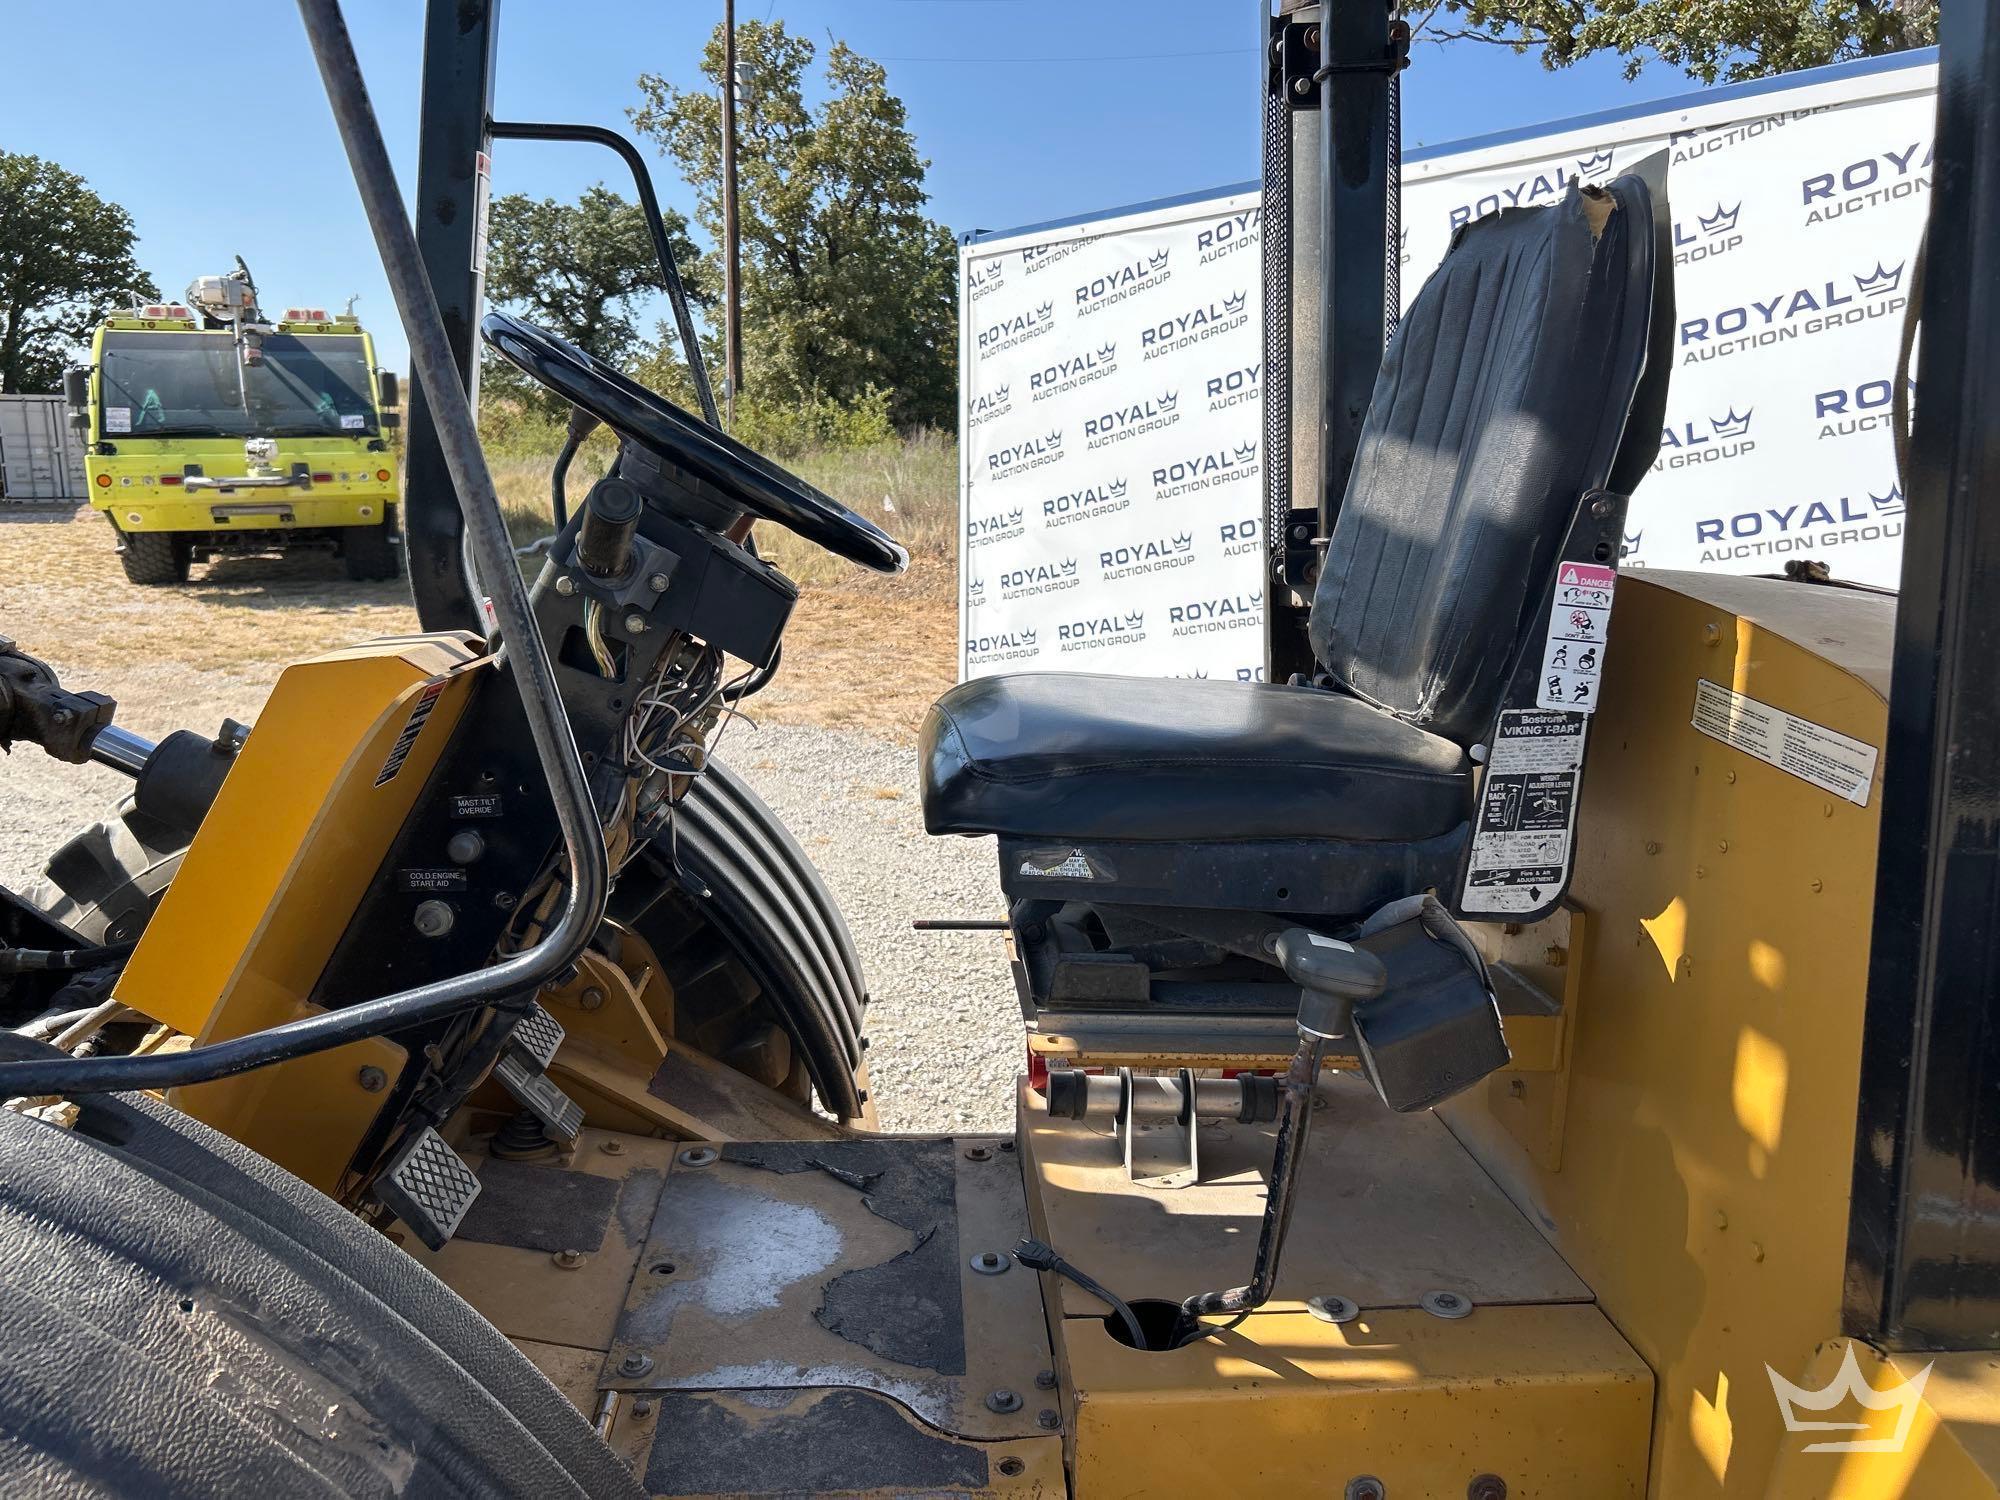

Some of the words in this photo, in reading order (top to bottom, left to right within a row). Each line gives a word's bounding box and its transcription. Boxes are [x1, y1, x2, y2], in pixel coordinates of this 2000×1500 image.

[1672, 113, 1785, 166] AUCTION
[1803, 138, 1935, 206] ROY
[1449, 168, 1569, 231] ROYAL
[1198, 207, 1262, 251] ROYA
[1025, 247, 1069, 275] AUCTION
[1200, 232, 1259, 266] AUCTION
[1674, 235, 1743, 267] ROUP
[1076, 261, 1149, 304] ROYAL
[1077, 290, 1126, 318] AUCTION
[1129, 271, 1171, 296] GROUP
[1142, 304, 1223, 348] ROYAL
[1681, 281, 1853, 346] ROYAL
[978, 312, 1036, 349] ROYAL
[1143, 333, 1198, 362] AUCTION
[1201, 315, 1248, 341] GROUP
[1683, 324, 1798, 366] AUCTION
[1804, 296, 1907, 335] GROUP
[1030, 353, 1097, 391] ROYAL
[1032, 379, 1076, 402] AUCTION
[1079, 364, 1118, 385] GROUP
[1207, 364, 1261, 398] ROY
[968, 393, 997, 416] YAL
[1209, 388, 1260, 412] AUCTIO
[1084, 400, 1158, 438] ROYAL
[1087, 427, 1136, 451] AUCTION
[1138, 413, 1180, 436] GROUP
[1819, 412, 1894, 440] AUCT
[988, 438, 1046, 470] ROYAL
[1669, 440, 1756, 471] GROUP
[1152, 452, 1234, 487] ROYAL
[1155, 478, 1210, 501] AUCTION
[1212, 465, 1259, 486] GROUP
[1043, 486, 1109, 516] ROYAL
[1045, 510, 1090, 529] AUCTION
[1091, 500, 1130, 518] GROUP
[968, 514, 1009, 537] OYAL
[1696, 497, 1868, 546] ROYAL
[1100, 539, 1174, 569] ROYAL
[1224, 541, 1262, 557] AUCTI
[1700, 523, 1814, 564] AUCTION
[1820, 522, 1902, 547] GROU
[1001, 564, 1060, 589] ROYAL
[1103, 564, 1152, 582] AUCTION
[1154, 555, 1195, 572] GROUP
[1580, 578, 1614, 588] DANGER
[1001, 585, 1042, 601] AUCTION
[1045, 579, 1080, 594] GROUP
[1169, 597, 1249, 623] ROYAL
[1058, 616, 1125, 640] ROYAL
[1172, 621, 1226, 637] AUCTION
[1228, 615, 1264, 629] GROU
[967, 635, 1021, 653] ROYAL
[1006, 648, 1040, 660] GROUP
[1061, 638, 1105, 653] AUCTION
[1107, 632, 1147, 646] GROUP
[1504, 726, 1542, 736] VIKING
[1488, 792, 1506, 801] BACK
[1490, 783, 1505, 791] LIFT
[458, 799, 479, 807] MAST
[480, 798, 496, 806] TILT
[458, 806, 492, 815] OVERIDE
[410, 872, 431, 880] COLD
[432, 872, 461, 880] ENGINE
[410, 880, 435, 888] START
[436, 879, 449, 887] AID
